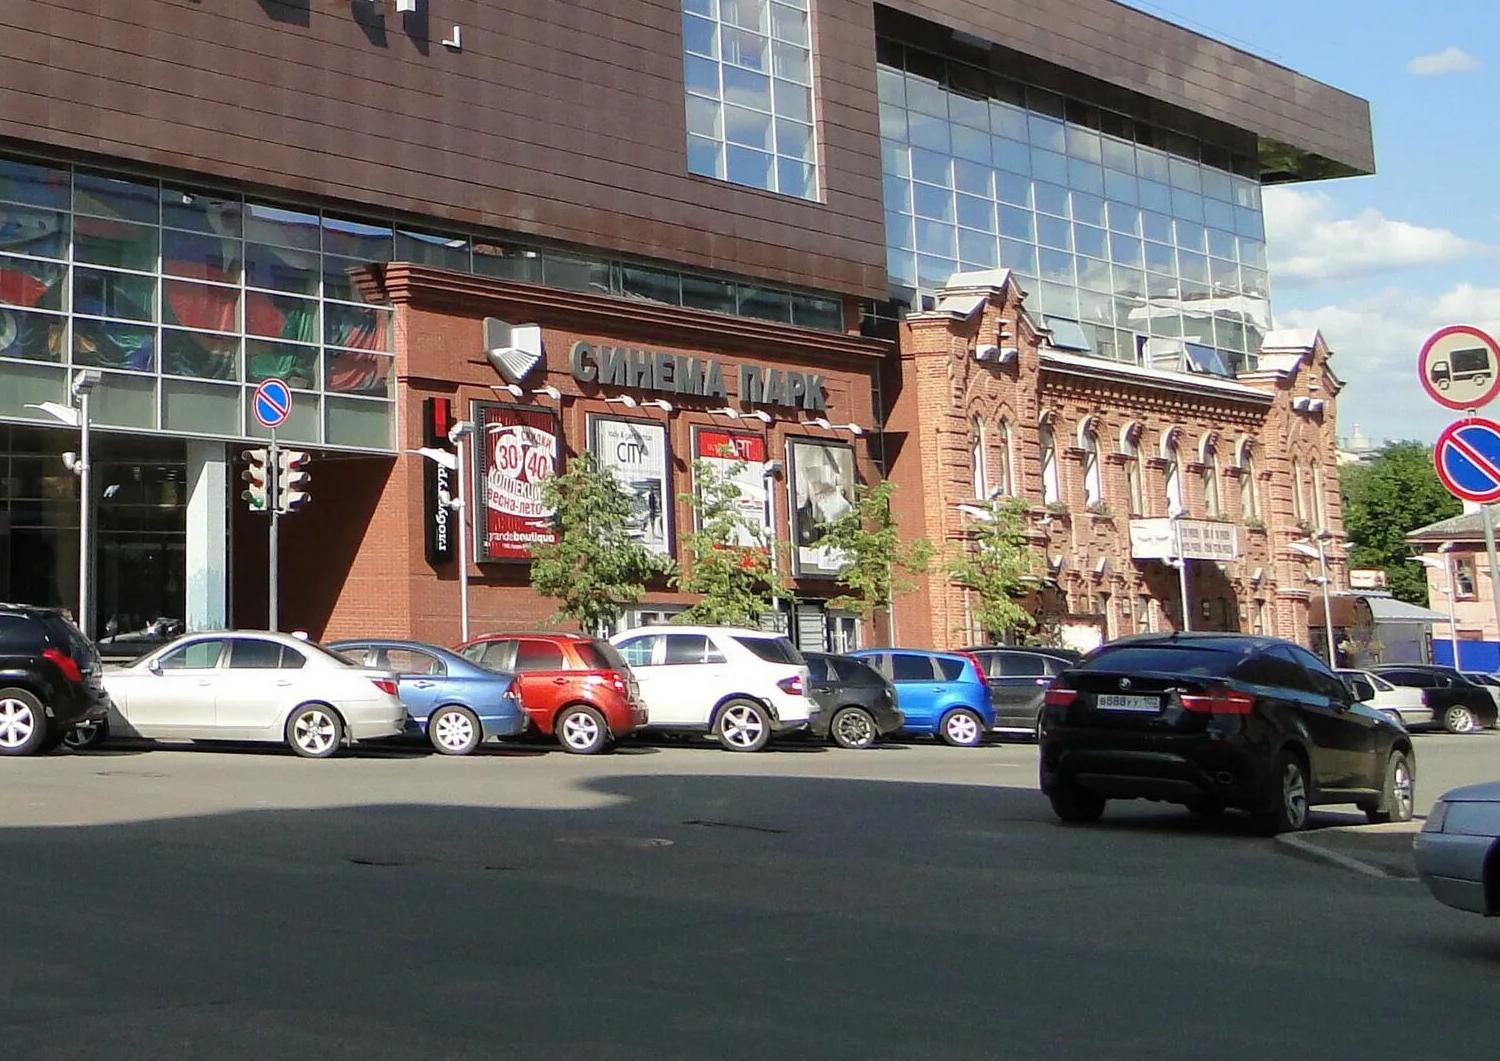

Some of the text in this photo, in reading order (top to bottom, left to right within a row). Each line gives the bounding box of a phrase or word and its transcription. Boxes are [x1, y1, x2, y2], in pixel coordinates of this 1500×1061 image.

[569, 340, 826, 411] СИНЕМА ПАРК
[616, 442, 645, 464] CITY
